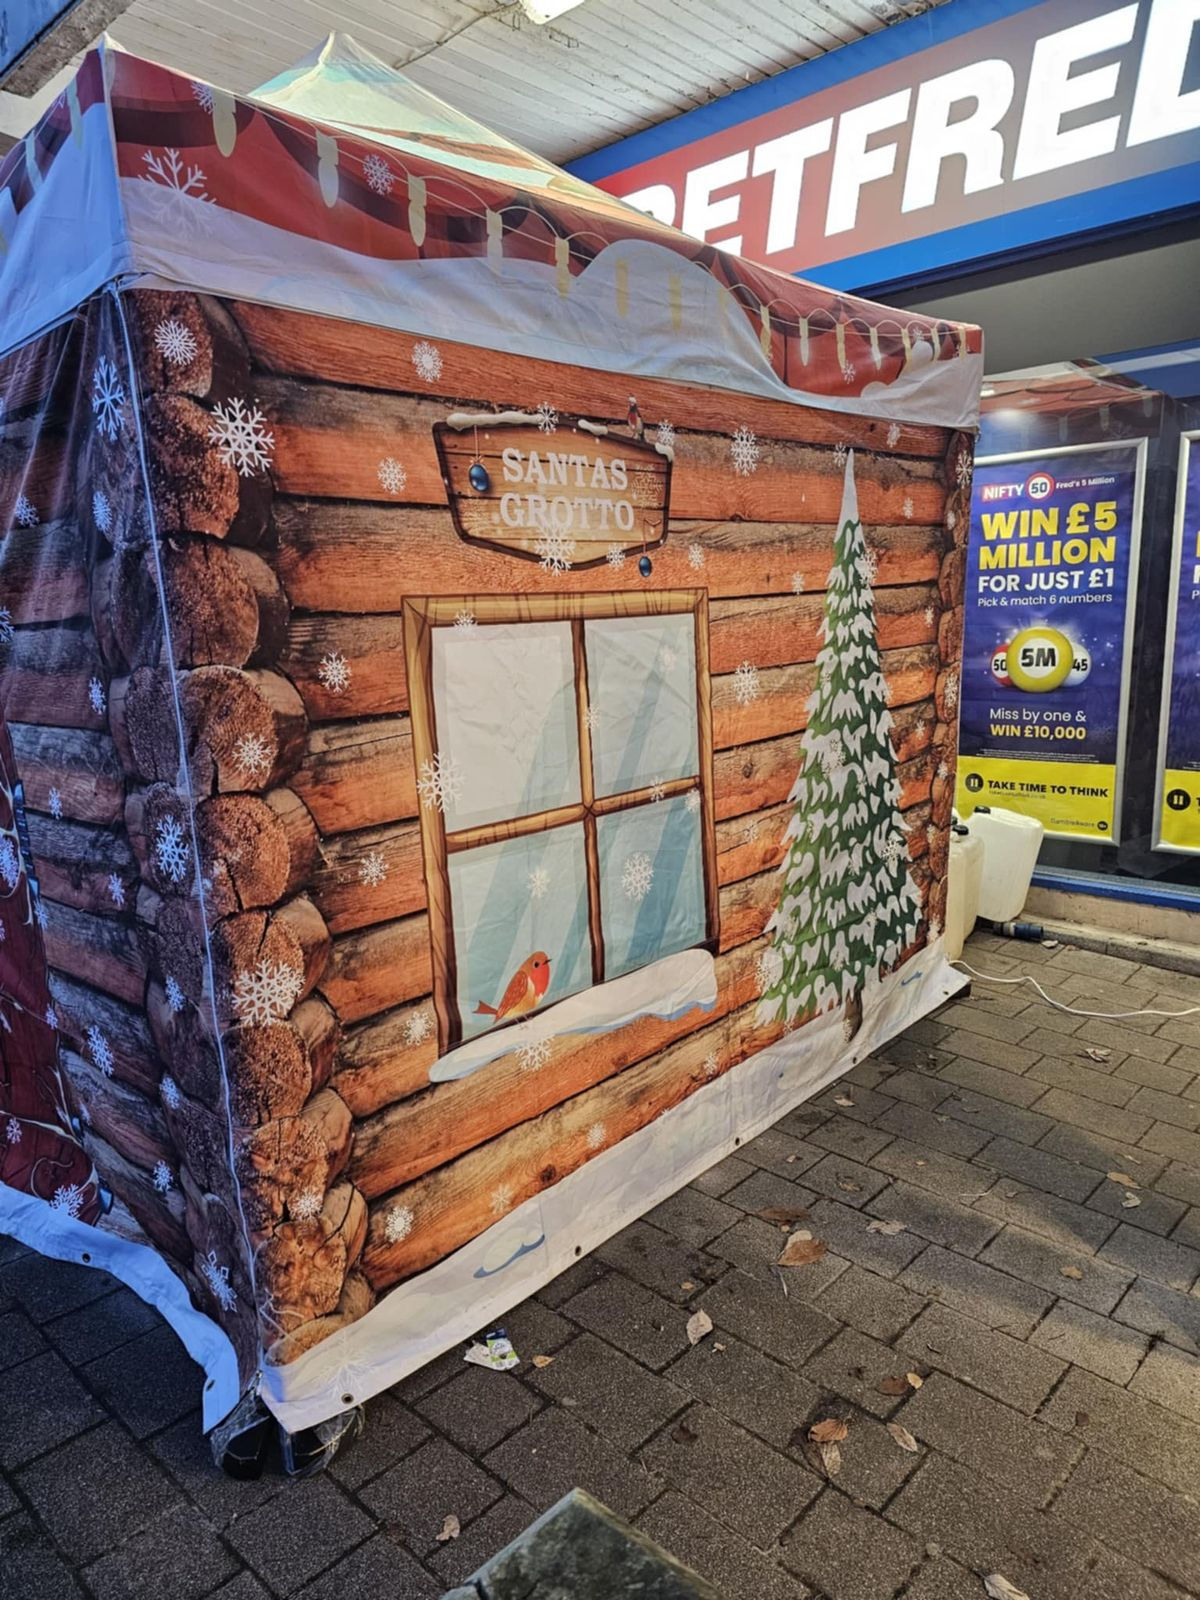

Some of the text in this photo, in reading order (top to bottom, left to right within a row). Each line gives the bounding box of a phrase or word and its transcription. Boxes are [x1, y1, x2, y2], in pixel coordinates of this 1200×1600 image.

[501, 447, 629, 491] SANTAS
[983, 484, 1024, 499] NIFTY
[1030, 482, 1048, 494] 50
[1088, 476, 1115, 485] Million
[500, 493, 635, 531] GROTTO
[981, 501, 1117, 540] WIN £5
[979, 536, 1116, 570] MILLION
[978, 567, 1114, 593] FOR JUST £1
[978, 593, 1112, 607] Pick & match 6 numbers
[1021, 647, 1056, 667] 5M
[1072, 658, 1088, 671] 45
[989, 707, 1086, 723] Miss by one &
[990, 724, 1086, 740] WIN £10,000
[988, 780, 1016, 791] TAKE
[1019, 783, 1047, 793] TIME
[1051, 785, 1066, 795] TO
[1070, 786, 1108, 798] THINK
